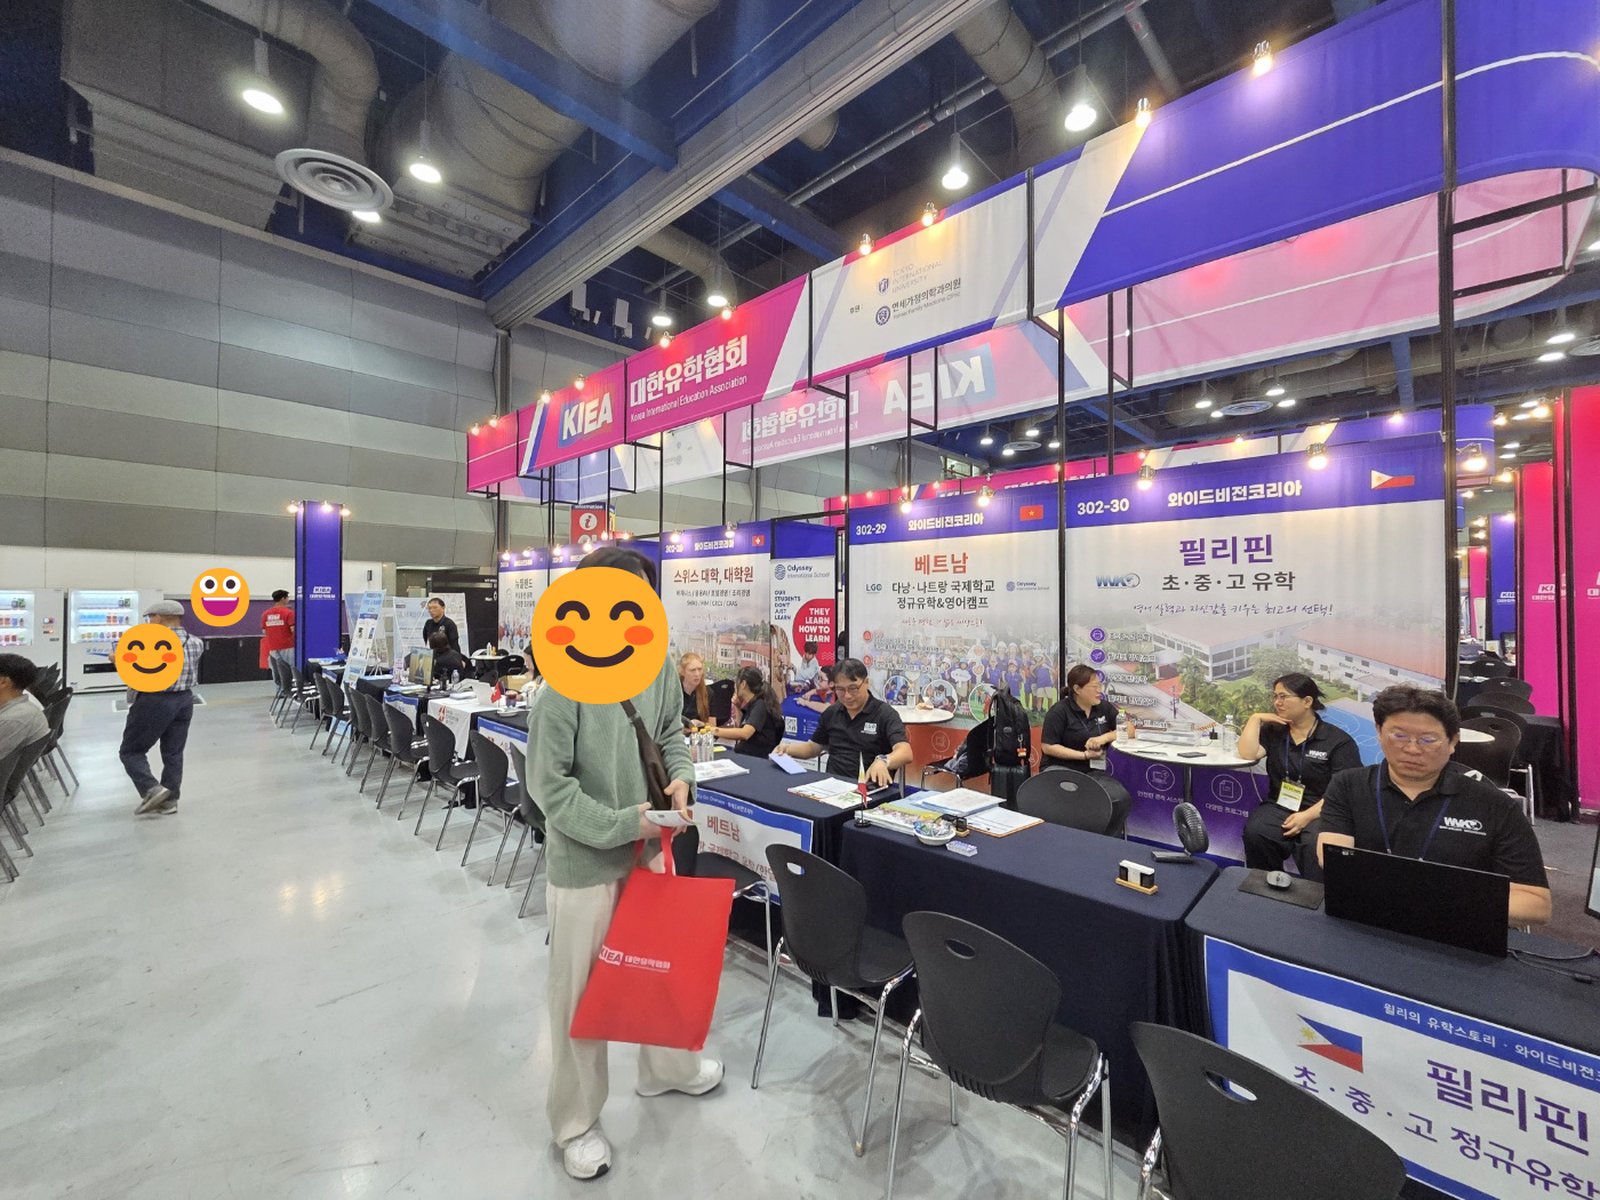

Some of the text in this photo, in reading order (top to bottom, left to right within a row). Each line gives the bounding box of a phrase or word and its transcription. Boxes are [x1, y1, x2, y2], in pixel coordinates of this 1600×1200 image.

[630, 336, 748, 407] 대한유학협회
[630, 375, 747, 423] Korea International Education Association
[562, 393, 613, 440] KIEA
[1077, 480, 1303, 516] 302-30 와이드비전코리아
[856, 513, 984, 536] 302-29 와이드비전코리아
[1179, 534, 1273, 567] 필리핀
[914, 552, 969, 575] 베트남
[674, 566, 754, 585] 스위스 대학, 대학원
[950, 580, 995, 593] 국제학교
[1252, 571, 1296, 592] 유학
[809, 607, 830, 616] THEY
[897, 596, 989, 610] 정규유학&영어캠프
[799, 625, 830, 633] HOW TO
[805, 617, 830, 625] LEARN
[805, 634, 830, 643] LEARN
[707, 815, 740, 842] 베트남
[1383, 1002, 1420, 1024] 윌리의
[1428, 1018, 1495, 1048] 유학스토리
[1427, 1059, 1590, 1155] 필리핀
